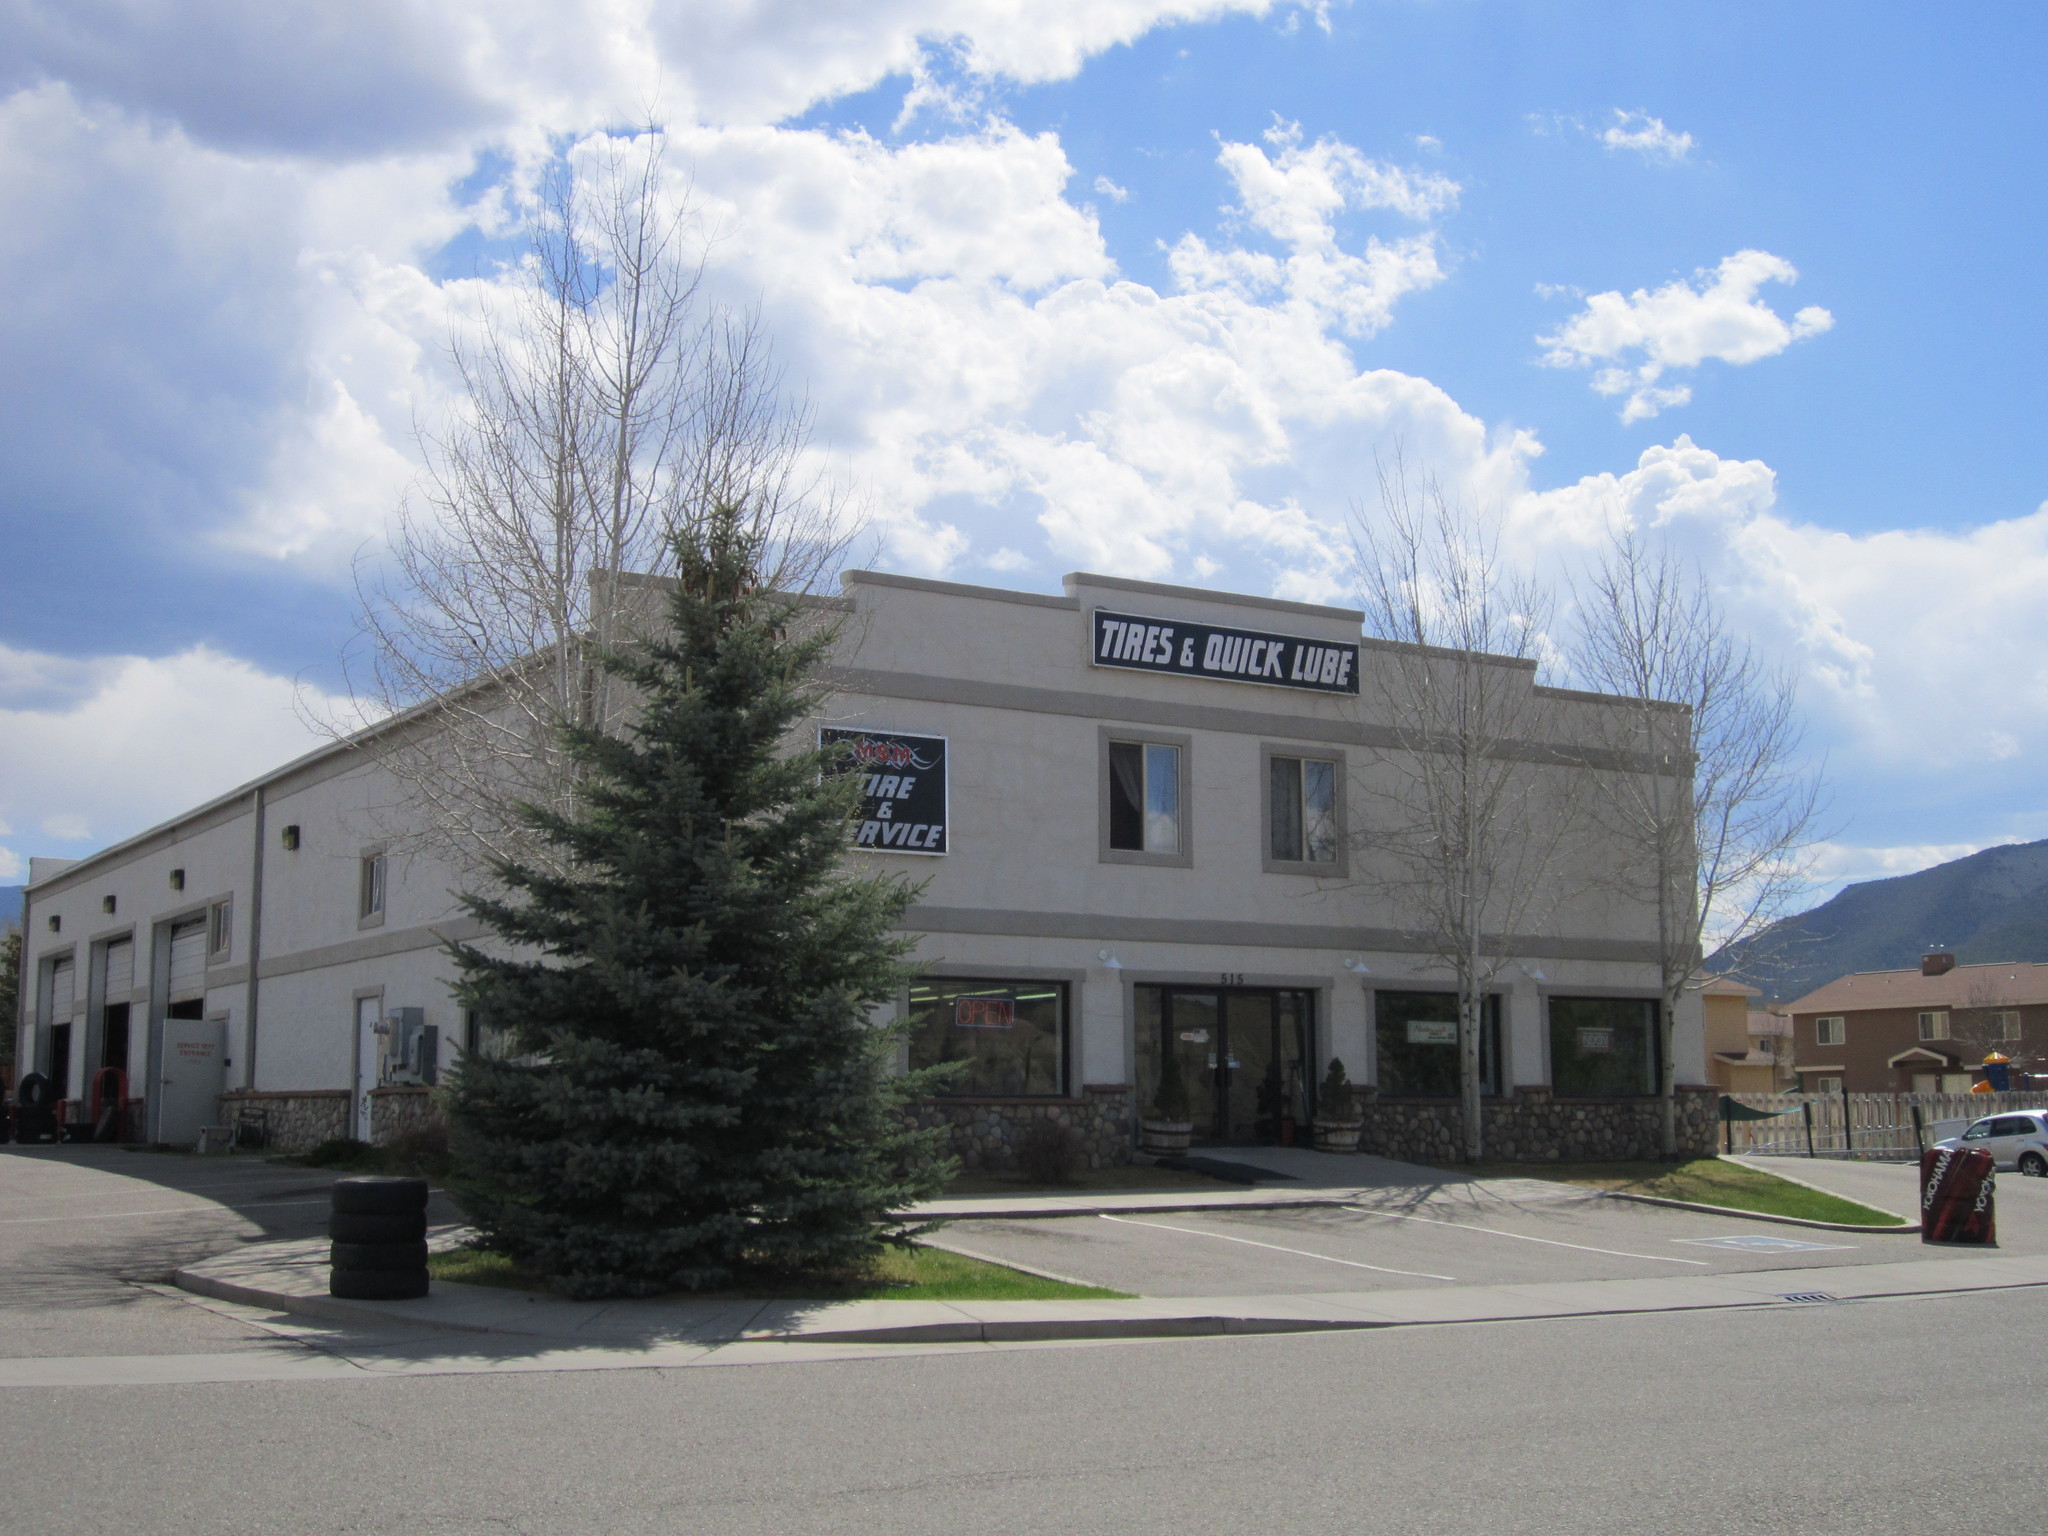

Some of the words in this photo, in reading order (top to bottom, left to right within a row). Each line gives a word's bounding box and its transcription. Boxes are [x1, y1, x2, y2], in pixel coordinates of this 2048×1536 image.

[1101, 620, 1174, 664] TIRES
[1179, 637, 1195, 668] &
[1203, 634, 1284, 678] QUICK
[1291, 645, 1354, 686] LUBE
[877, 802, 892, 818] &
[1219, 972, 1244, 985] 515
[959, 999, 1012, 1025] OPEN
[1923, 1151, 1951, 1210] YOKOHAMA
